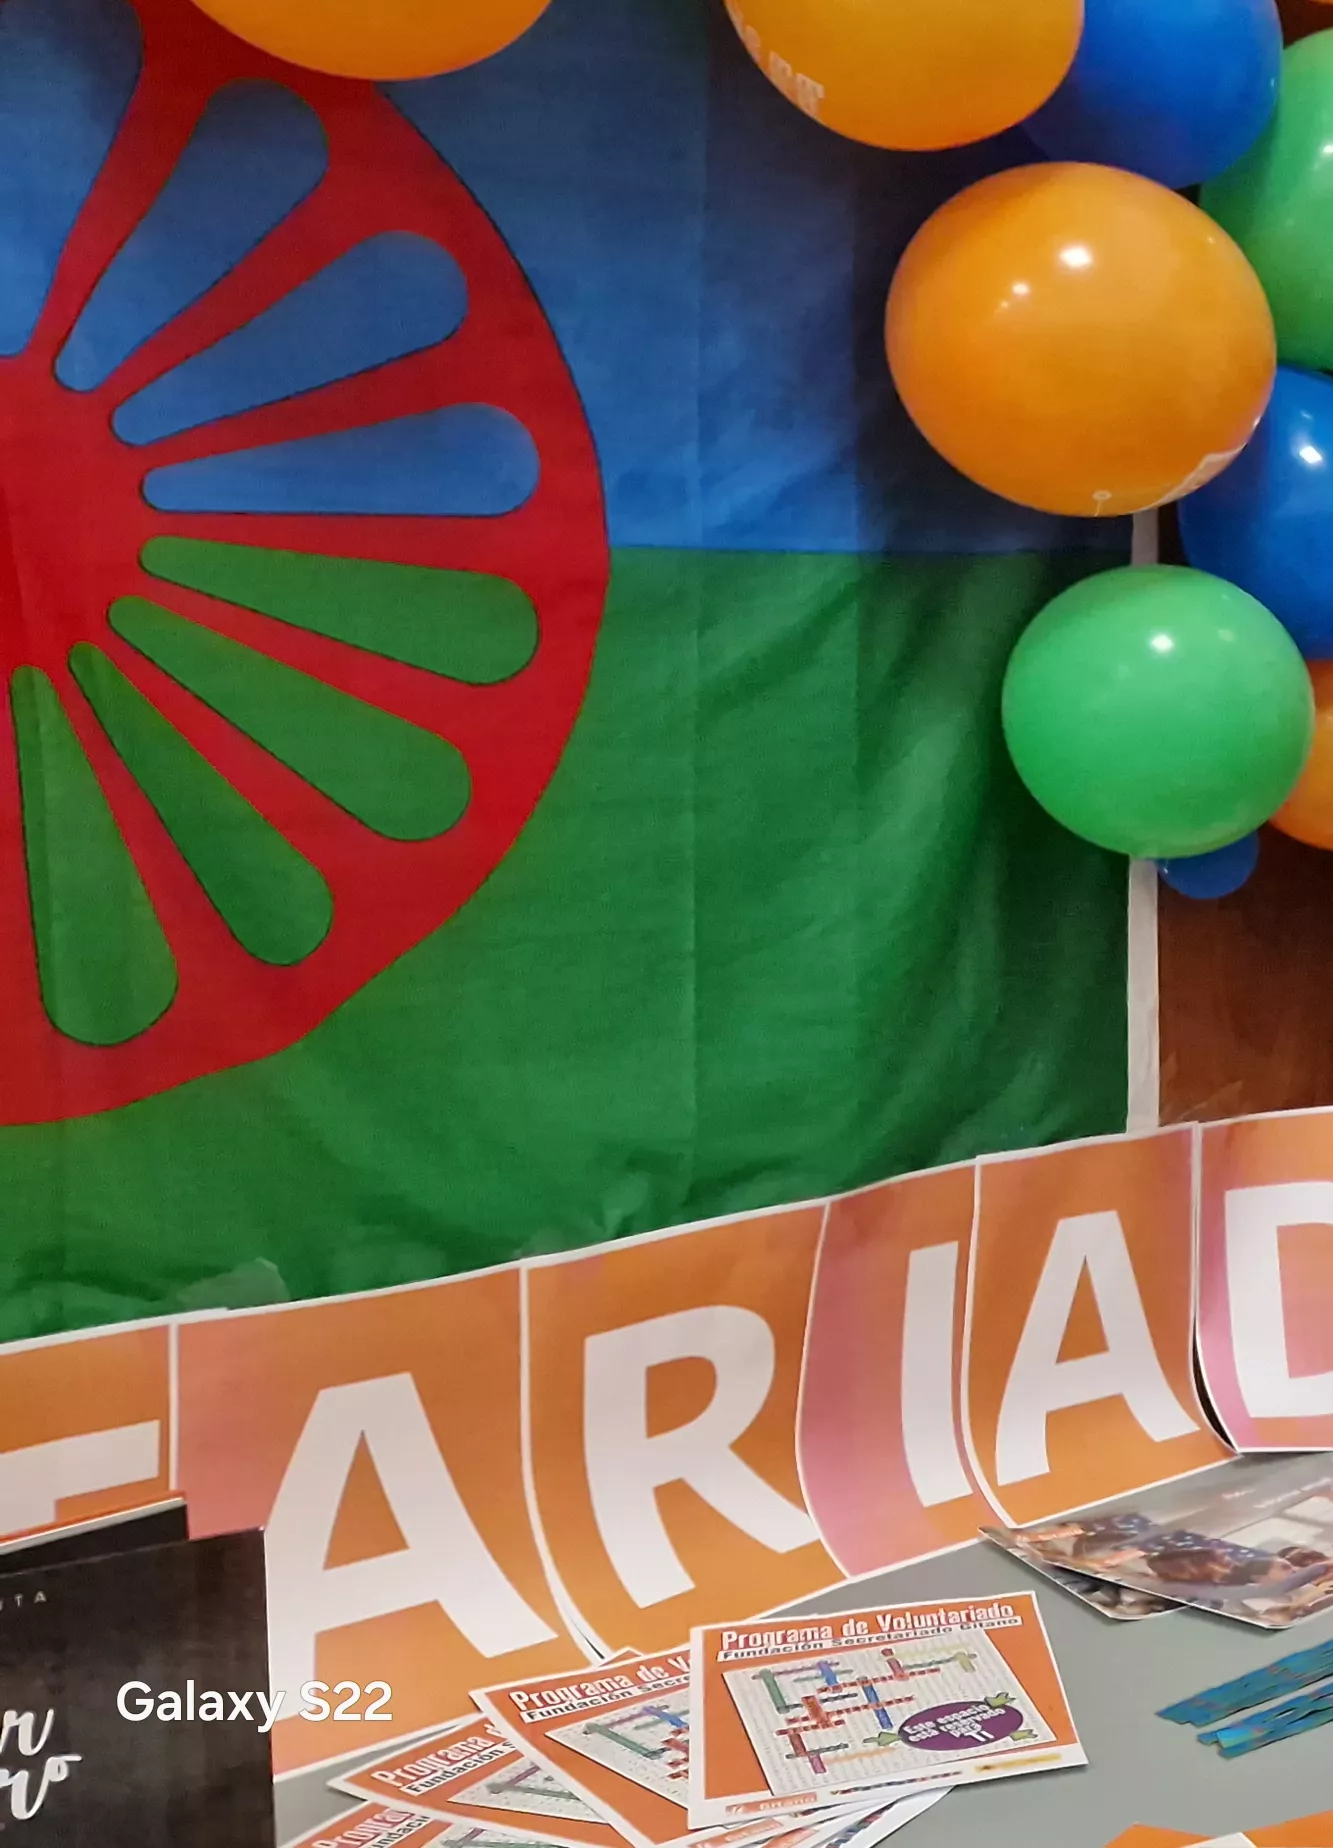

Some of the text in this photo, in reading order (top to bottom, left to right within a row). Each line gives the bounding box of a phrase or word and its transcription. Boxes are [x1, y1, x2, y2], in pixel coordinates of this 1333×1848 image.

[720, 1602, 1015, 1652] Programa de Voluntariado
[722, 1616, 1020, 1660] Fundación Secretariado Gitano
[509, 1674, 635, 1712] Programa
[636, 1664, 670, 1683] de
[526, 1690, 633, 1722] Fundación
[370, 1735, 496, 1788] Programa
[406, 1748, 502, 1794] Fundación
